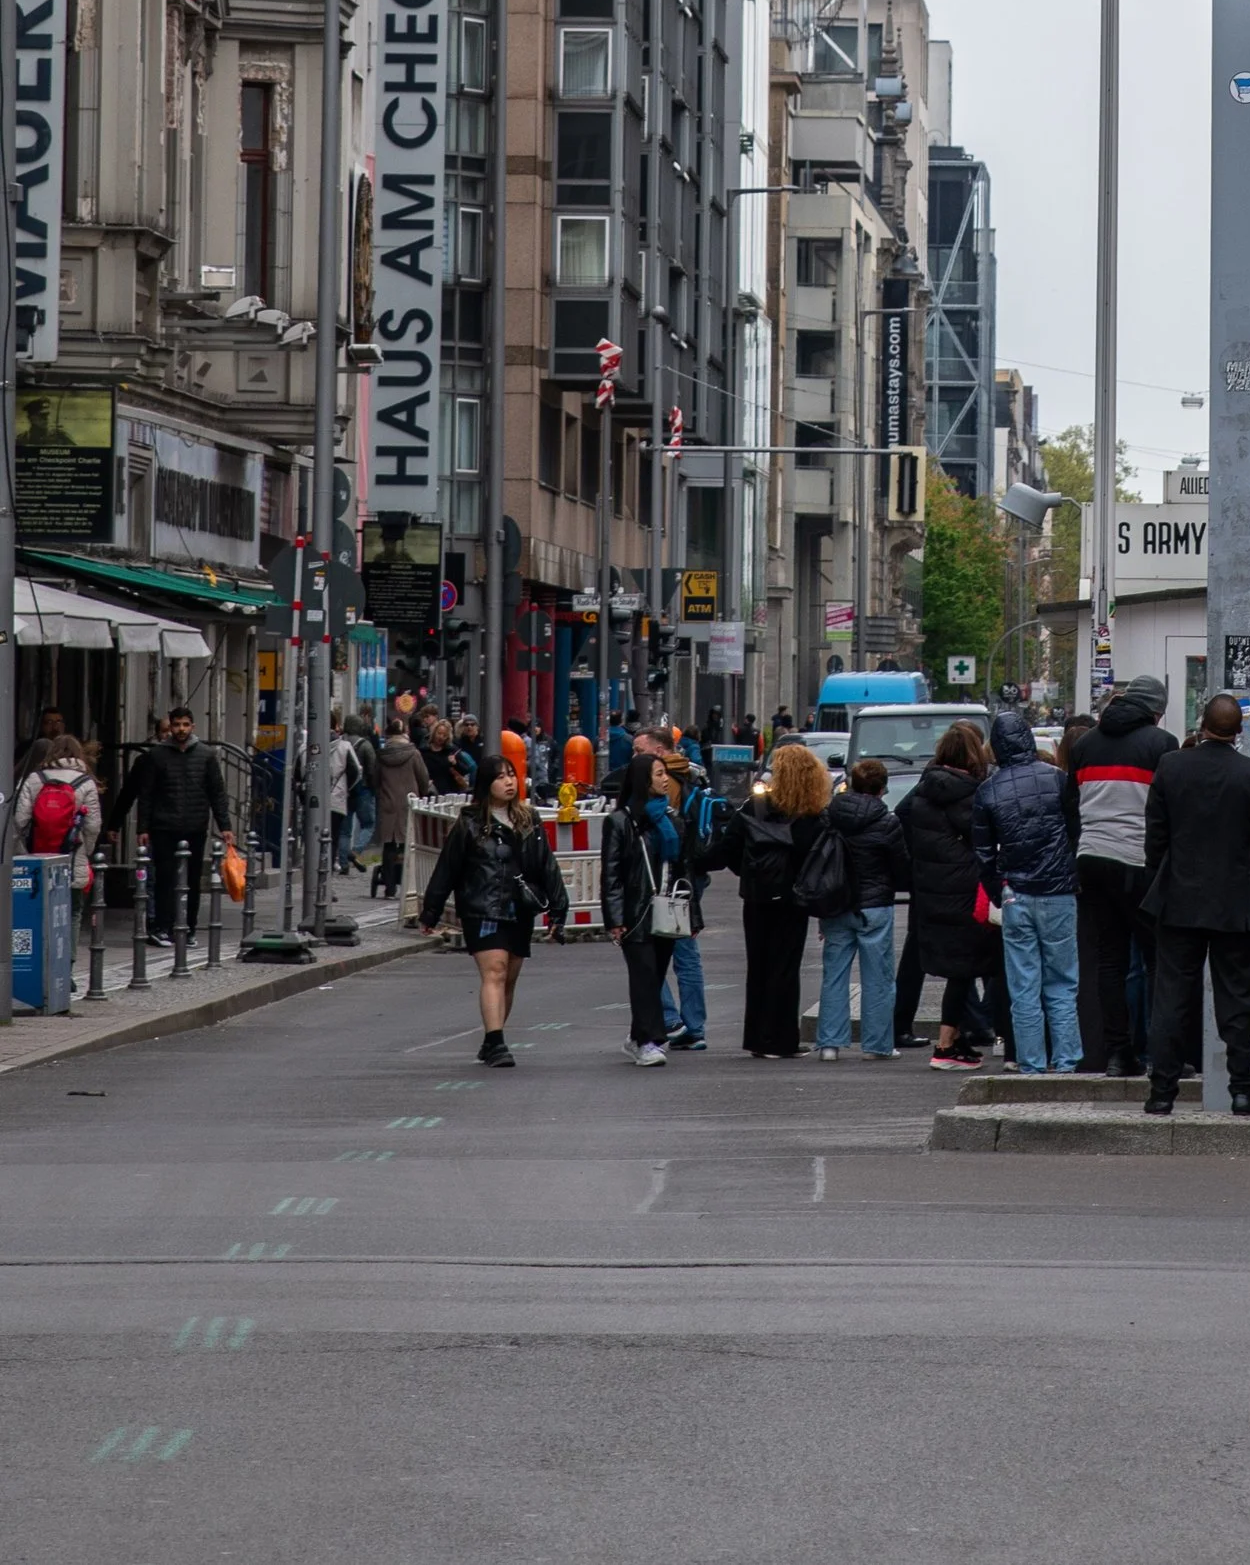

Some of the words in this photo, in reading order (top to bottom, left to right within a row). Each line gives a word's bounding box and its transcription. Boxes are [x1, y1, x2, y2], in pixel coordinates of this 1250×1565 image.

[380, 174, 436, 286] AM
[375, 307, 433, 486] HAUS
[1118, 522, 1130, 554] S
[1143, 522, 1206, 554] ARMY
[688, 605, 712, 613] ATM
